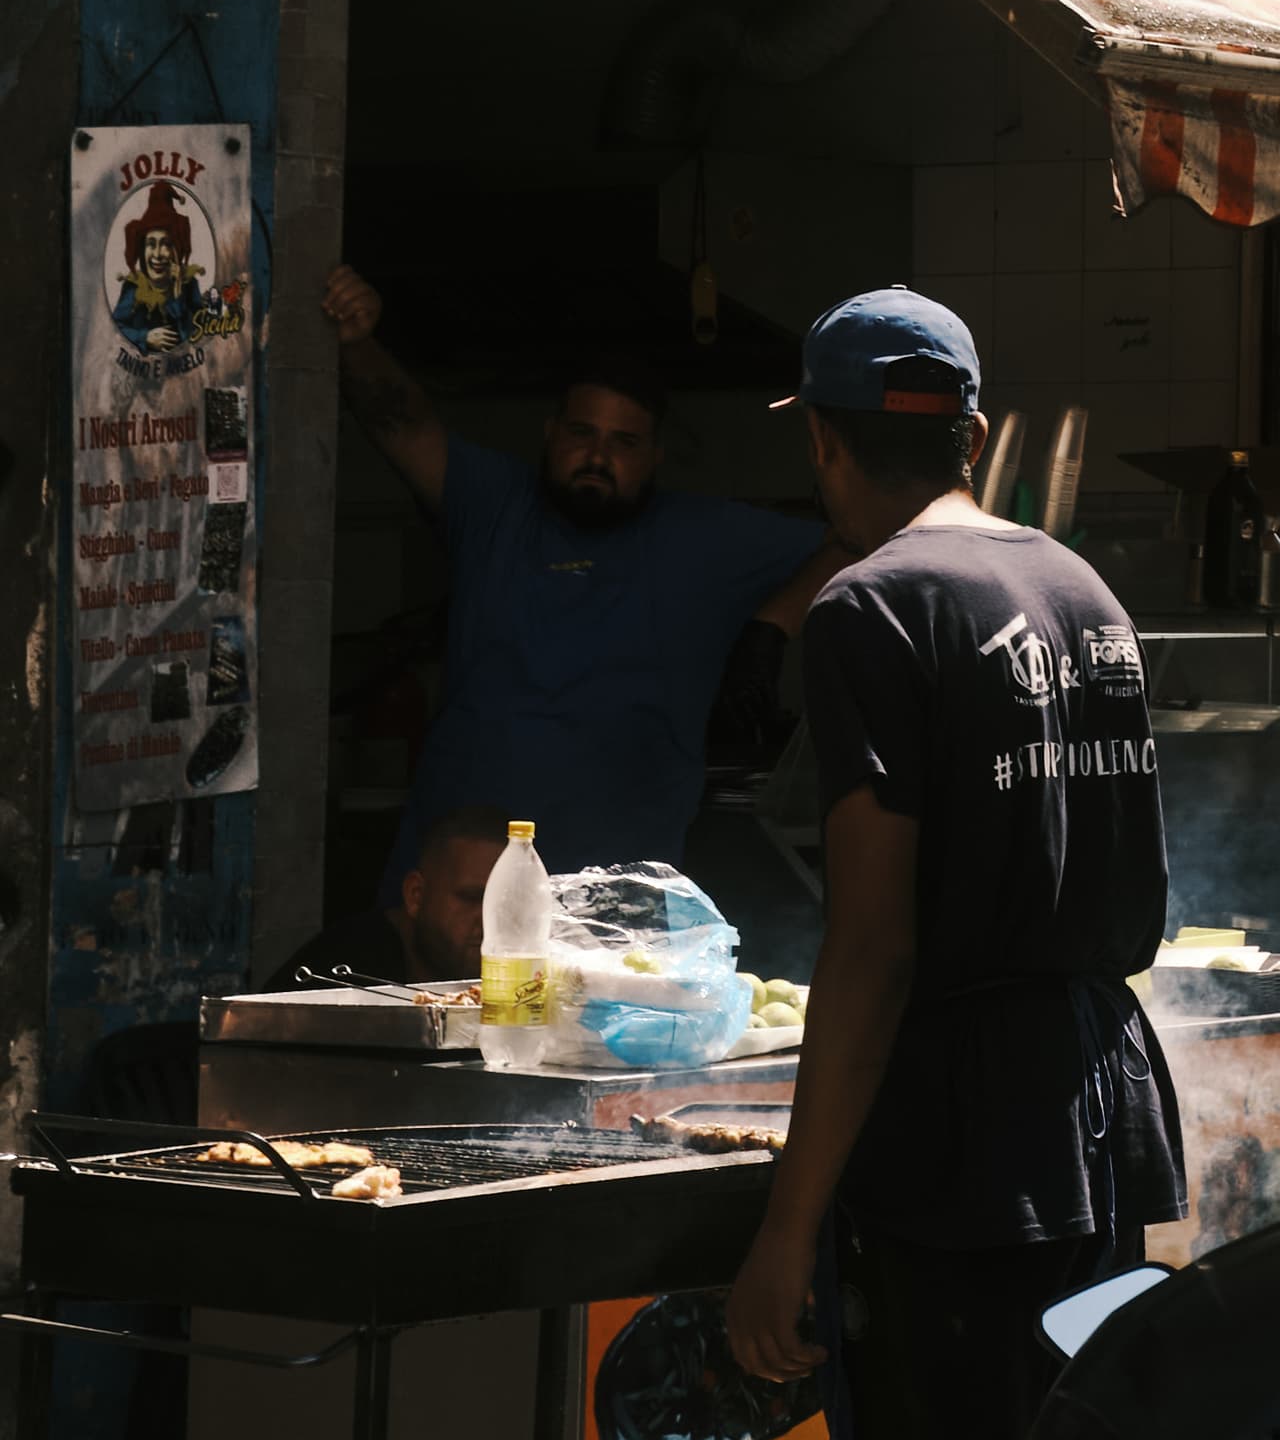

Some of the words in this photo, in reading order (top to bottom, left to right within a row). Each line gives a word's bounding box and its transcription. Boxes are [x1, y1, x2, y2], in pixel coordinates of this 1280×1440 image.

[119, 150, 206, 192] JOLLY
[79, 417, 87, 451] I
[90, 413, 137, 449] Nostri
[141, 407, 198, 445] Arrosti
[80, 637, 115, 664] Vitello
